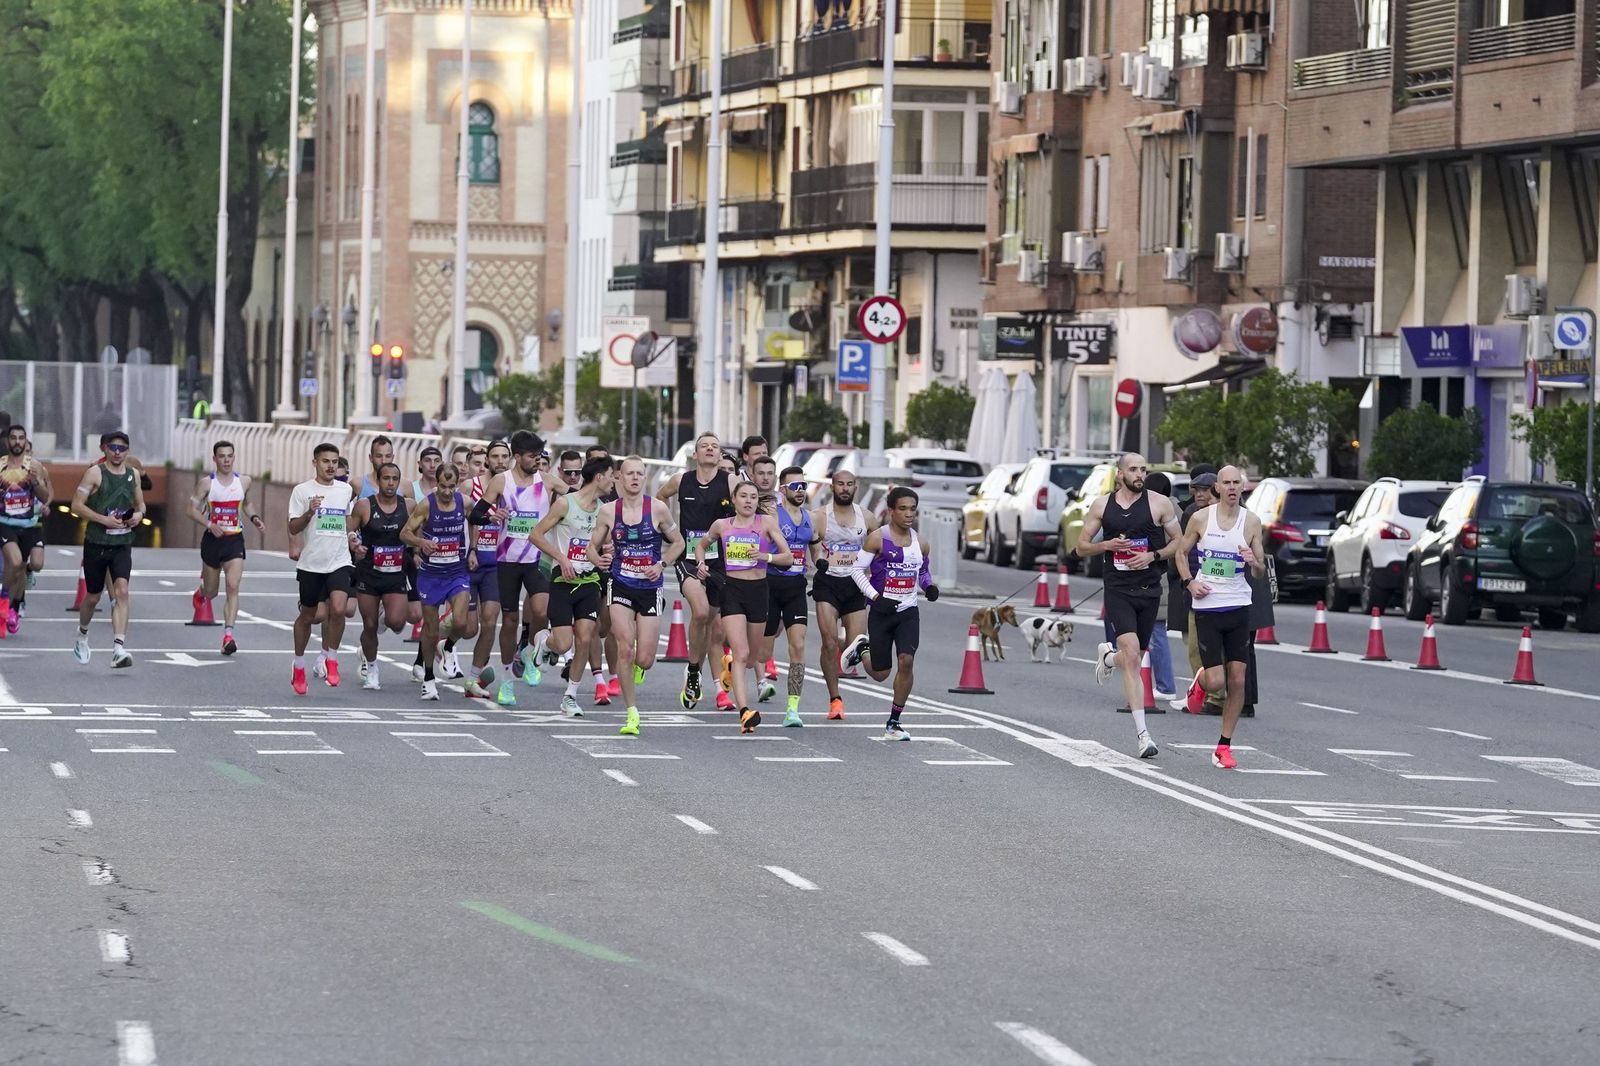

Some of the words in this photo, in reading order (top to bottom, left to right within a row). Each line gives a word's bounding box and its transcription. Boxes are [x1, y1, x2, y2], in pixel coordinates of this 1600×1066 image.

[1054, 328, 1107, 341] TINTE
[1067, 341, 1101, 363] 5€
[842, 345, 863, 372] P
[321, 522, 342, 530] ALFARO
[507, 525, 529, 533] STEVEN
[1210, 568, 1225, 576] ROB
